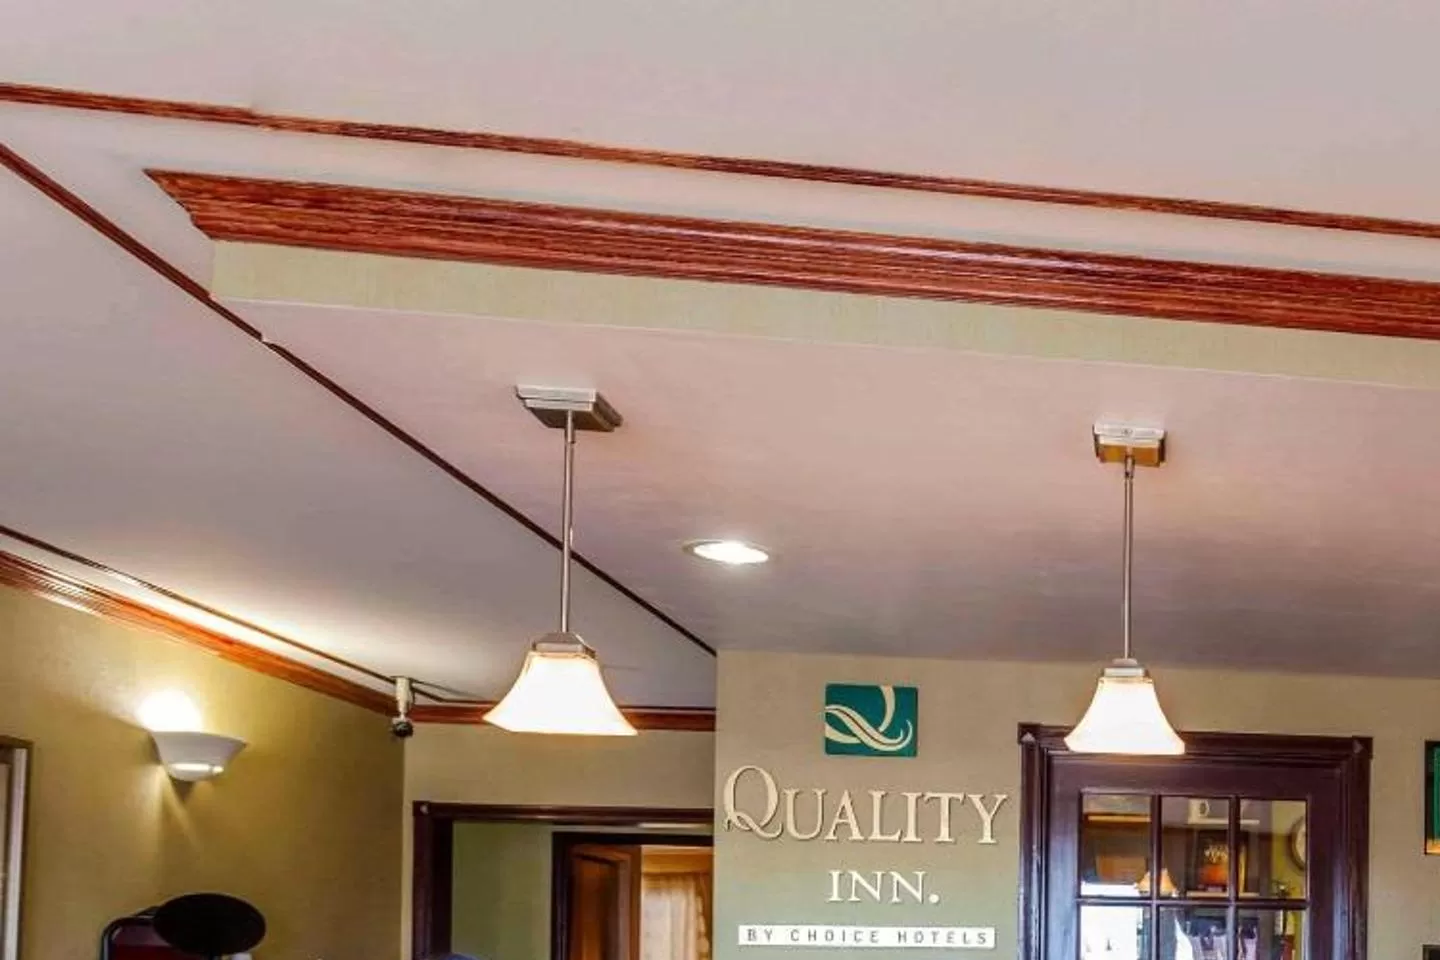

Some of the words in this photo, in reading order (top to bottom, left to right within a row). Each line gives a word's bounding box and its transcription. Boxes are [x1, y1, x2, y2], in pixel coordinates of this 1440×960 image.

[723, 765, 1009, 844] QUALITY
[746, 928, 773, 943] BY
[789, 928, 880, 944] CHOICE
[896, 930, 988, 945] HOTELS
